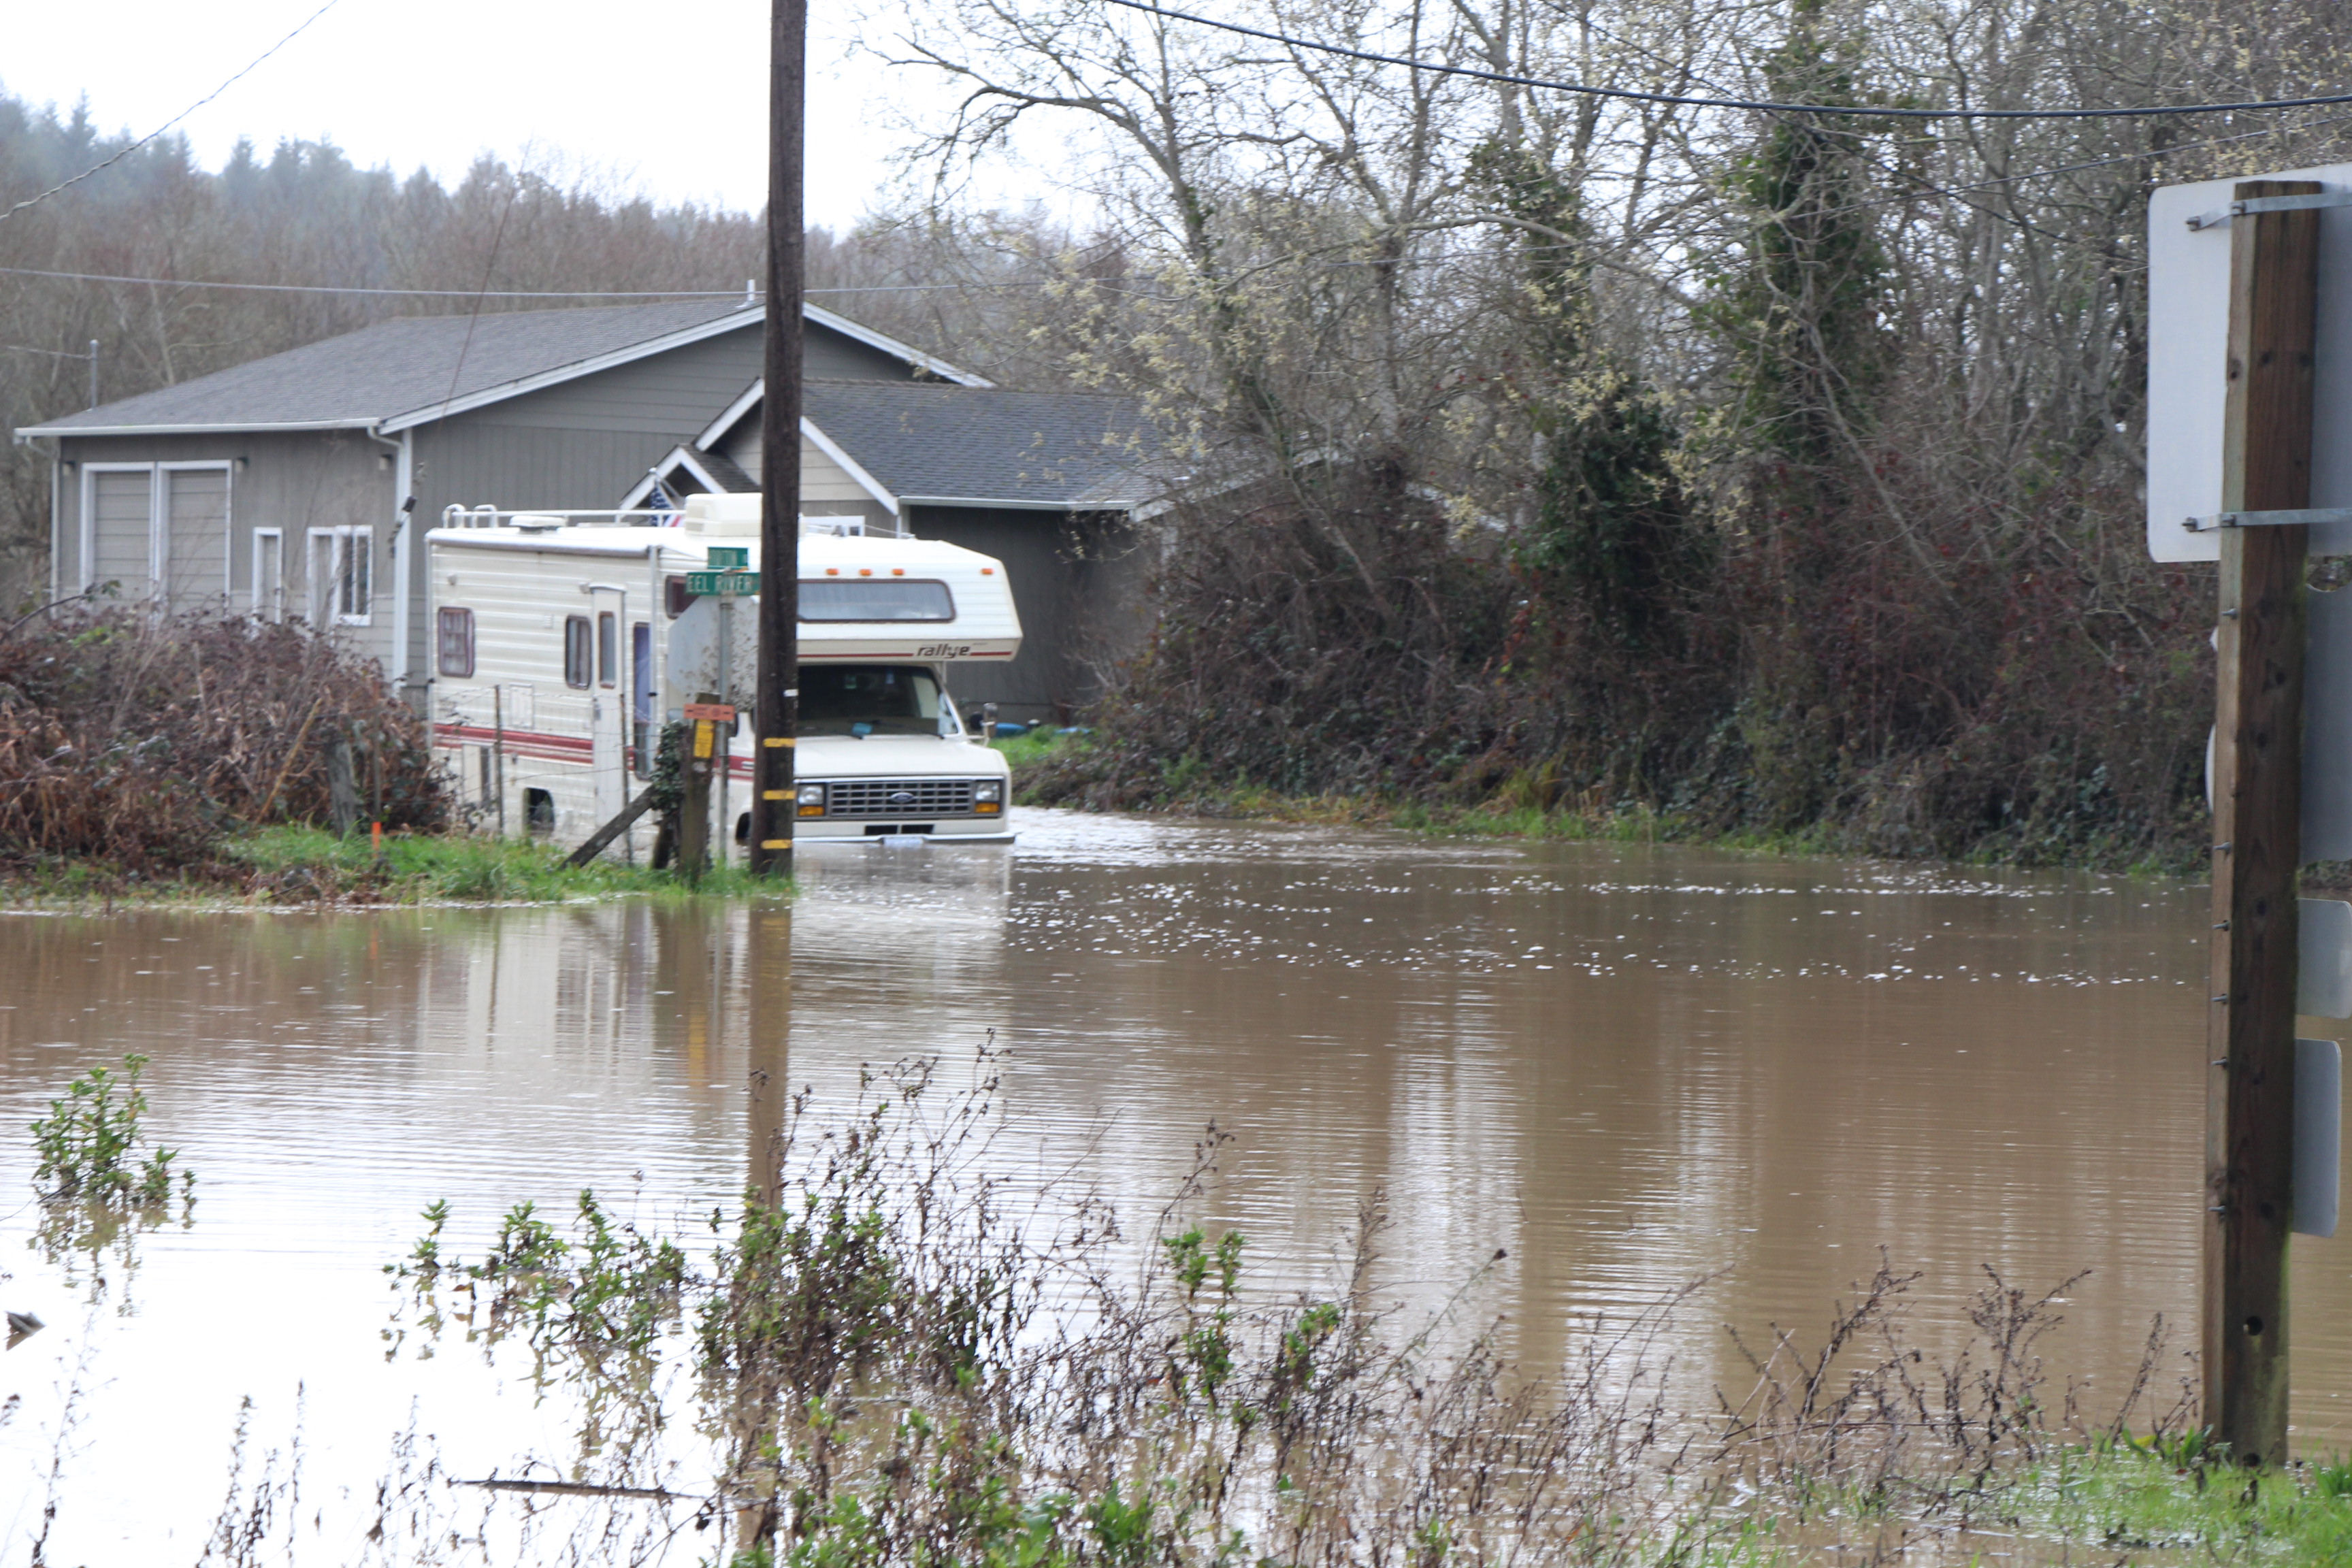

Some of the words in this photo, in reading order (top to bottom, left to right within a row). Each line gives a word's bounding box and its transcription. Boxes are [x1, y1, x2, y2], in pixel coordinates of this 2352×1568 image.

[686, 575, 709, 592] EEL
[715, 575, 752, 592] RIVER
[917, 643, 970, 659] rallye
